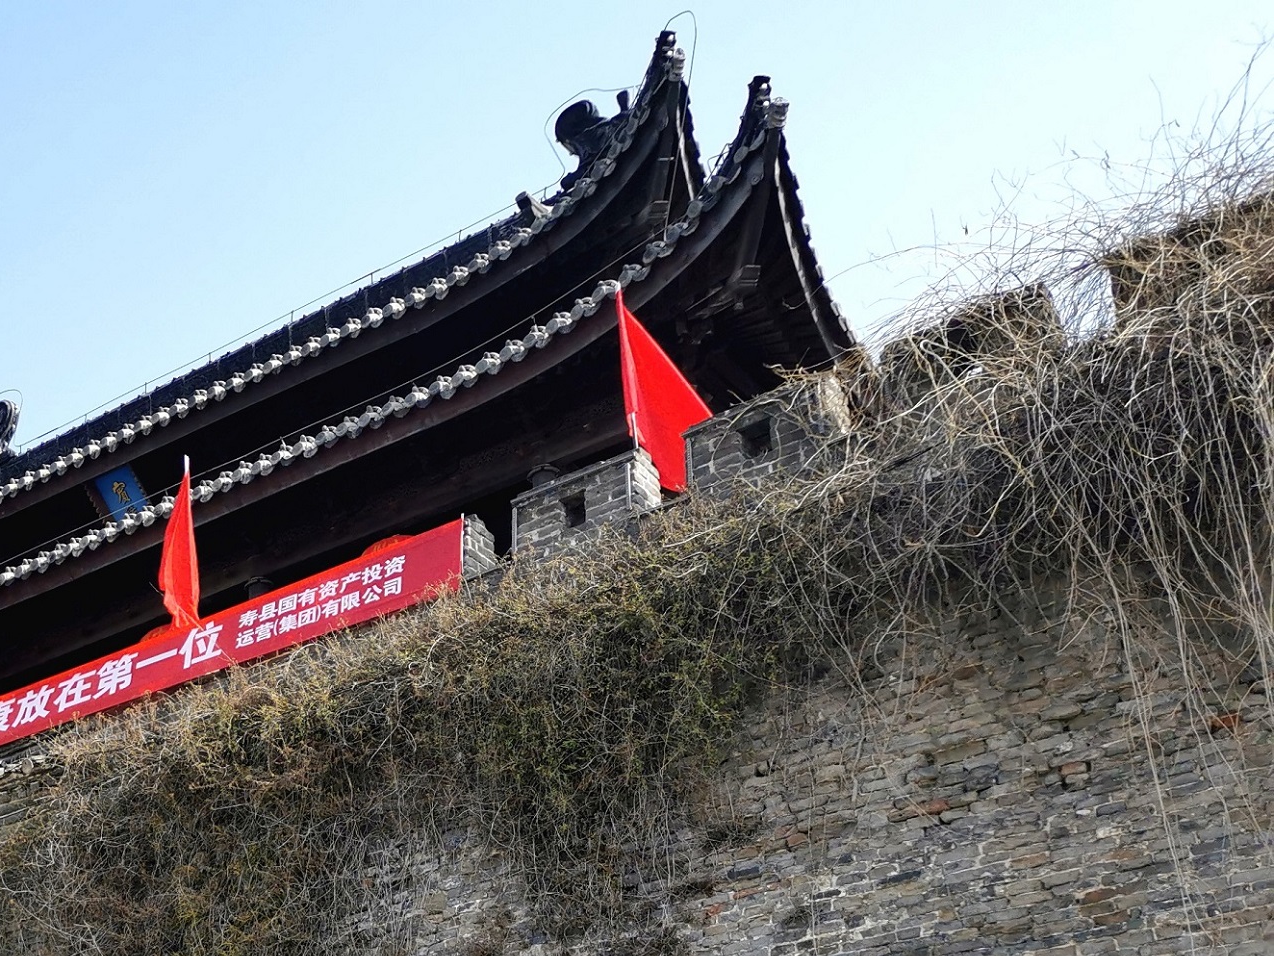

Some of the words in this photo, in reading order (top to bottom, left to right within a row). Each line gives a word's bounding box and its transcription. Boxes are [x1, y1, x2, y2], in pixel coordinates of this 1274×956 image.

[235, 577, 402, 649] 运营(集团)有限公司
[238, 555, 406, 628] 寿县国有资产投资
